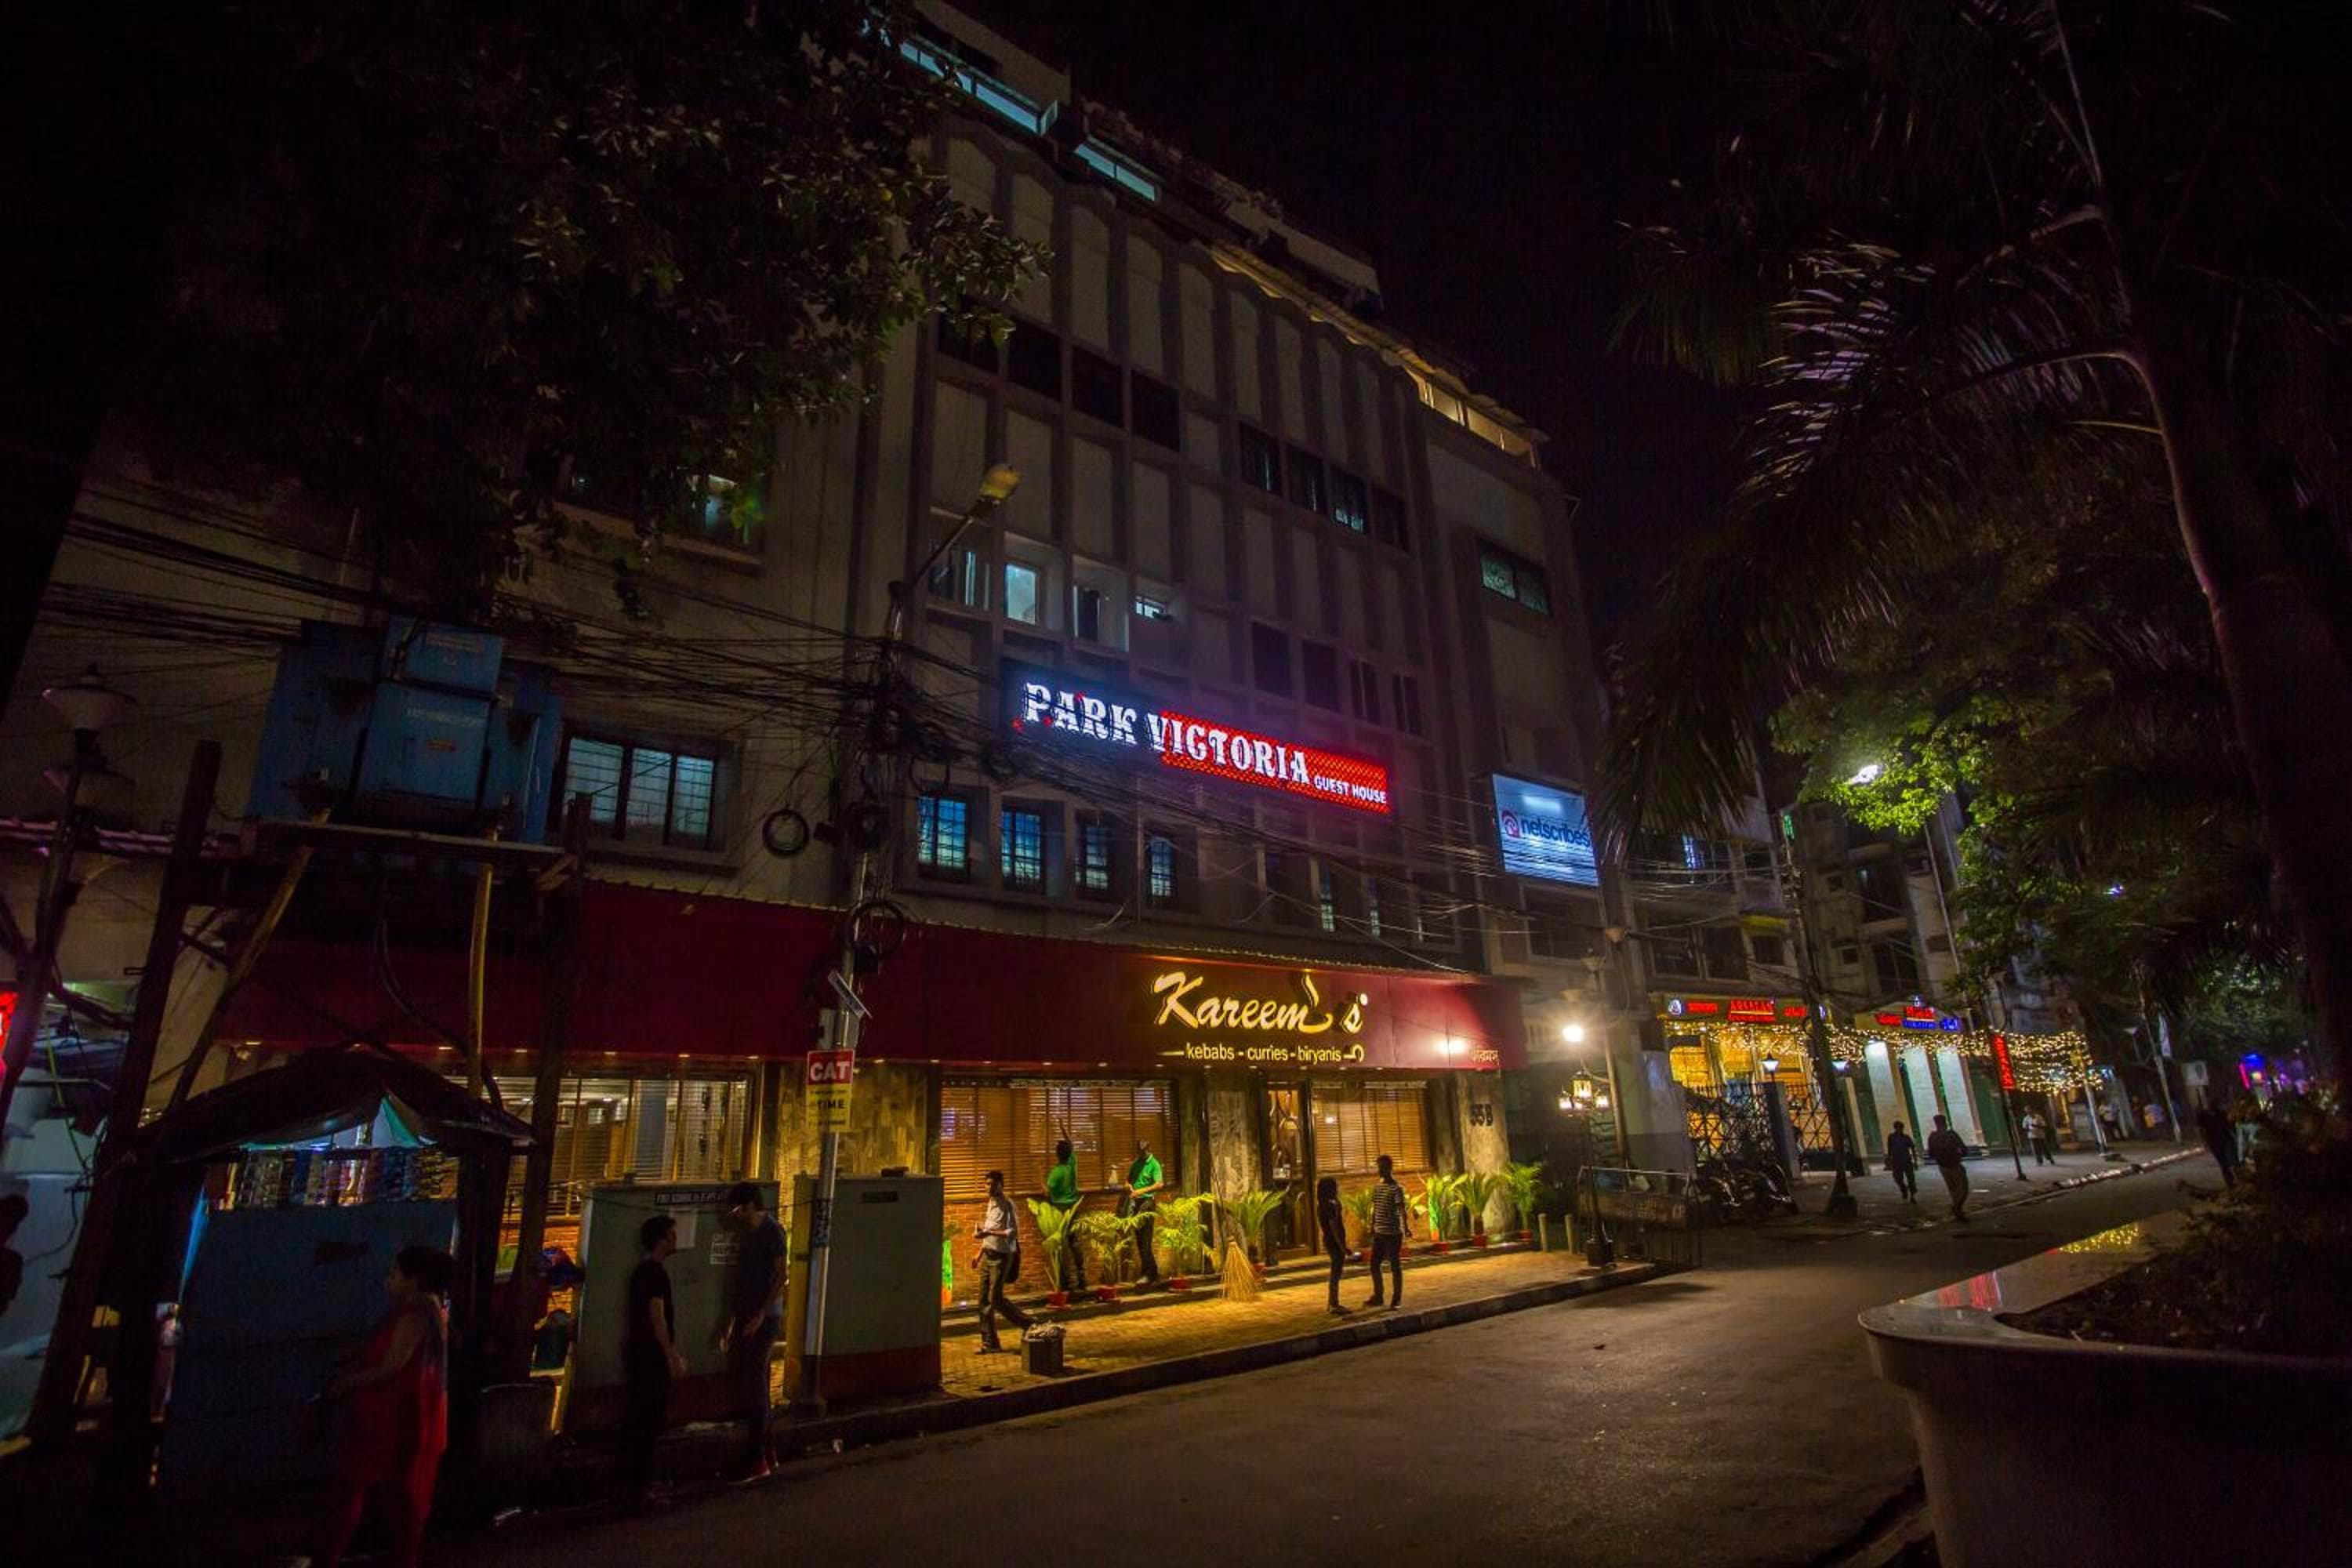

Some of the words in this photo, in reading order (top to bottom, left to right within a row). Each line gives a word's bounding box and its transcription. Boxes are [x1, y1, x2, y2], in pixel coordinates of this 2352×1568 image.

[1023, 682, 1138, 745] PARK
[1145, 713, 1310, 785] VICTORIA
[1315, 775, 1348, 796] GUEST
[1352, 785, 1387, 804] HOUSE
[1521, 818, 1591, 848] netscribes
[1186, 1042, 1235, 1060] kebabs
[1247, 1044, 1288, 1062] curries
[1298, 1045, 1341, 1065] biryanis
[810, 1061, 850, 1082] CAT
